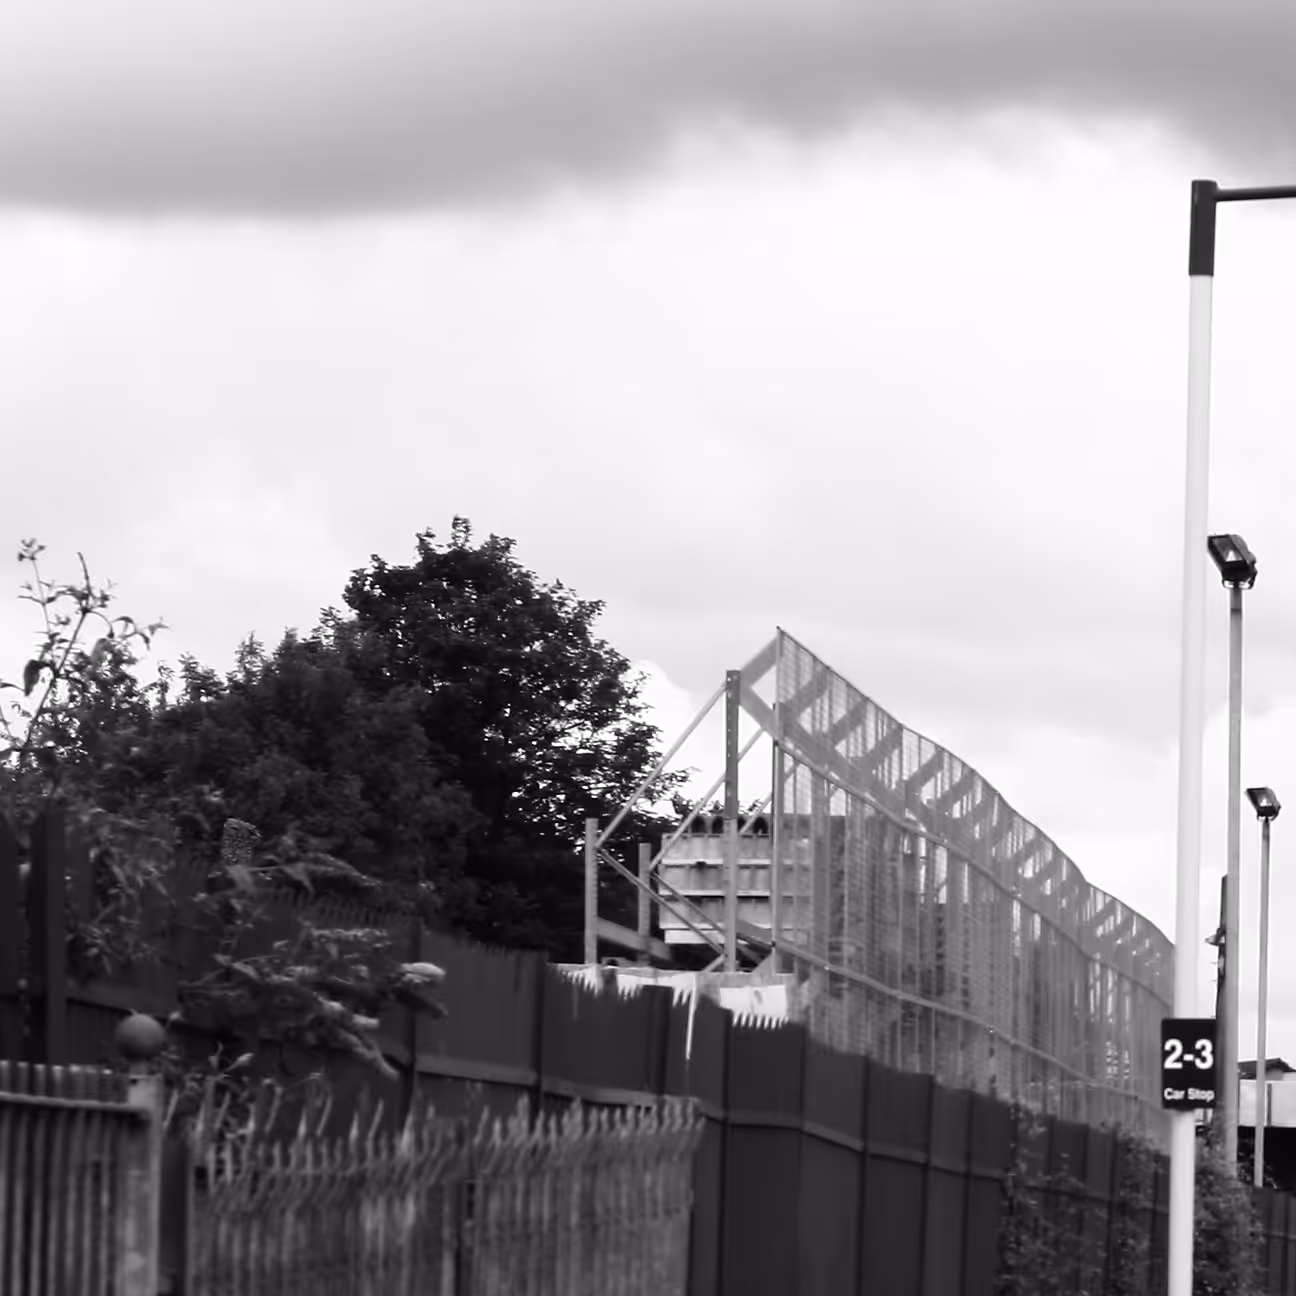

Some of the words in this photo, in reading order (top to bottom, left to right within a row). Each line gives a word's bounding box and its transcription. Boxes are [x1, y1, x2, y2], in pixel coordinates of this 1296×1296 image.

[1164, 1038, 1214, 1070] 2-3
[1163, 1087, 1185, 1100] Car
[1187, 1087, 1215, 1103] Stop
